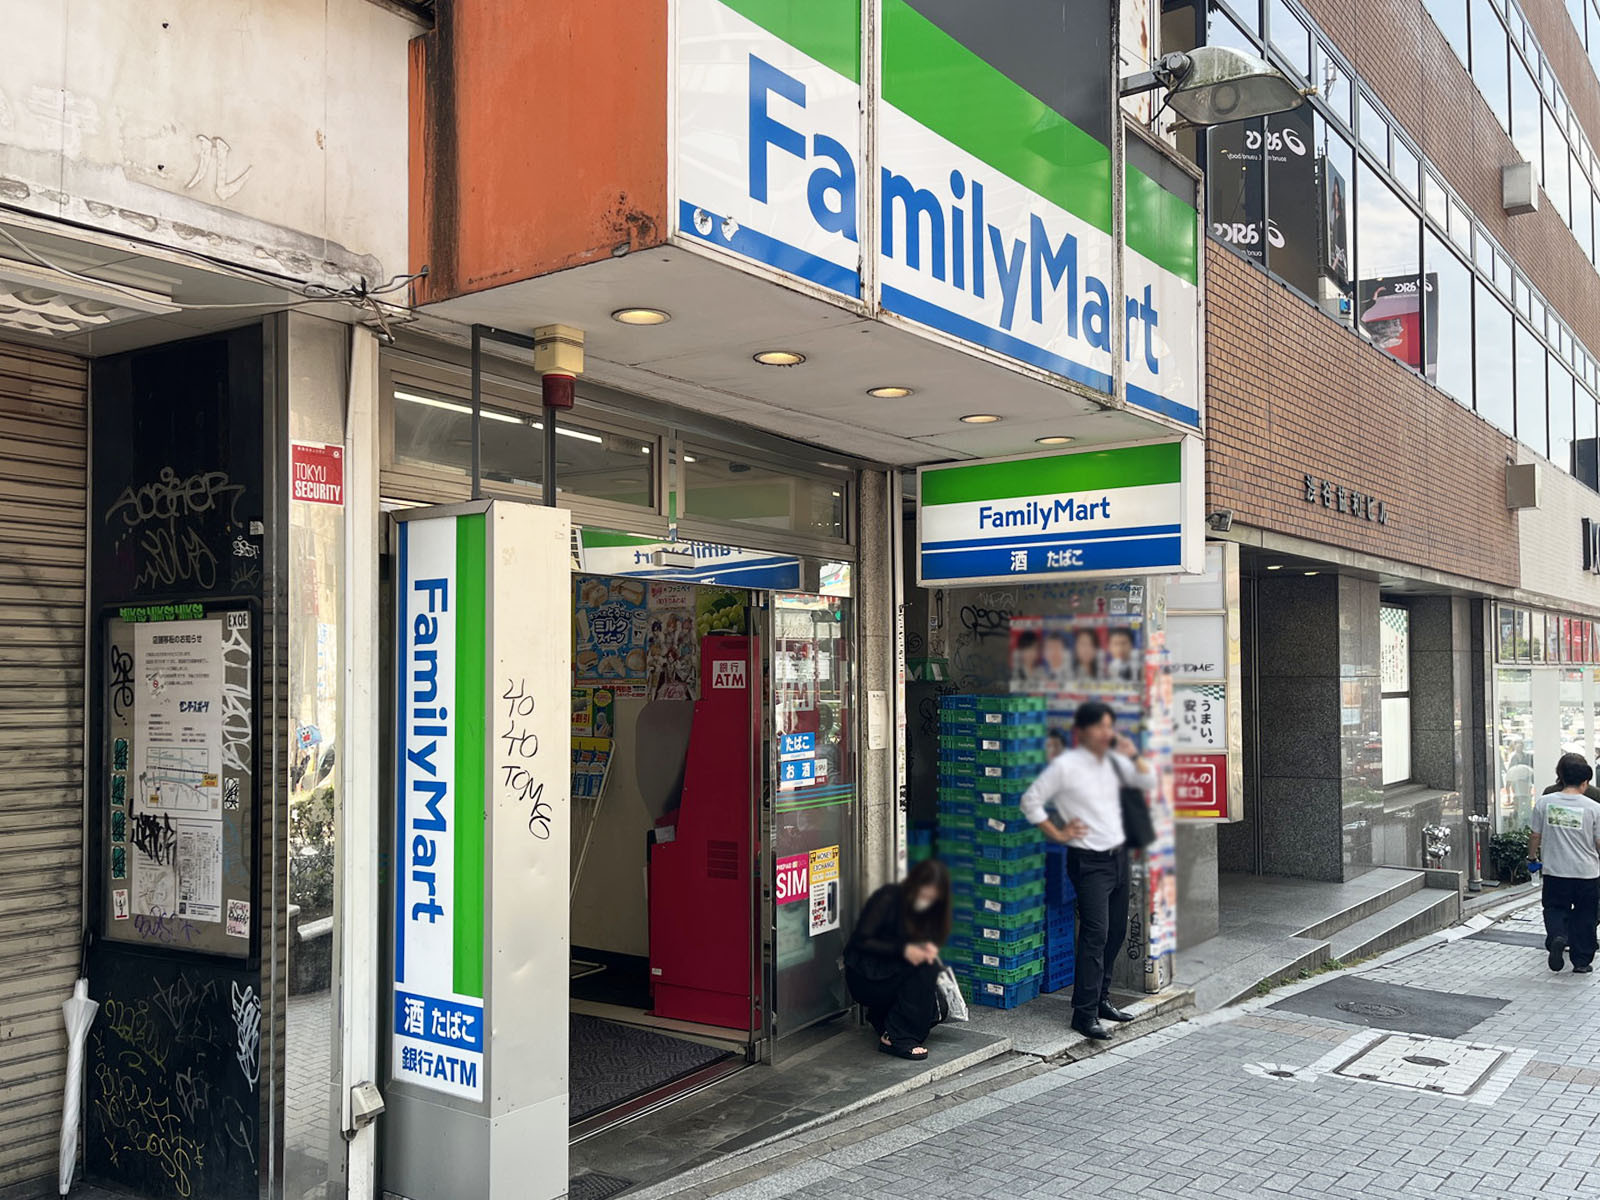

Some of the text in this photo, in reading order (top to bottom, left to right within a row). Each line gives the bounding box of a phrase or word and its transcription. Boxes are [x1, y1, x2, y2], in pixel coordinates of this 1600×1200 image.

[748, 52, 1159, 374] FamilyMart
[294, 462, 326, 482] TOKYU
[295, 480, 341, 502] SECURITY
[979, 496, 1111, 530] FamilyMart
[1010, 549, 1084, 571] 酒 たばこ
[593, 619, 629, 633] ミルク
[597, 632, 626, 645] スイーツ
[720, 662, 739, 673] 銀行
[714, 673, 744, 687] ATM
[407, 577, 448, 924] FamilyMart
[785, 735, 810, 752] たばこ
[776, 868, 807, 899] SIM
[403, 997, 476, 1044] 酒 たばこ
[401, 1045, 477, 1088] 銀行ATM
